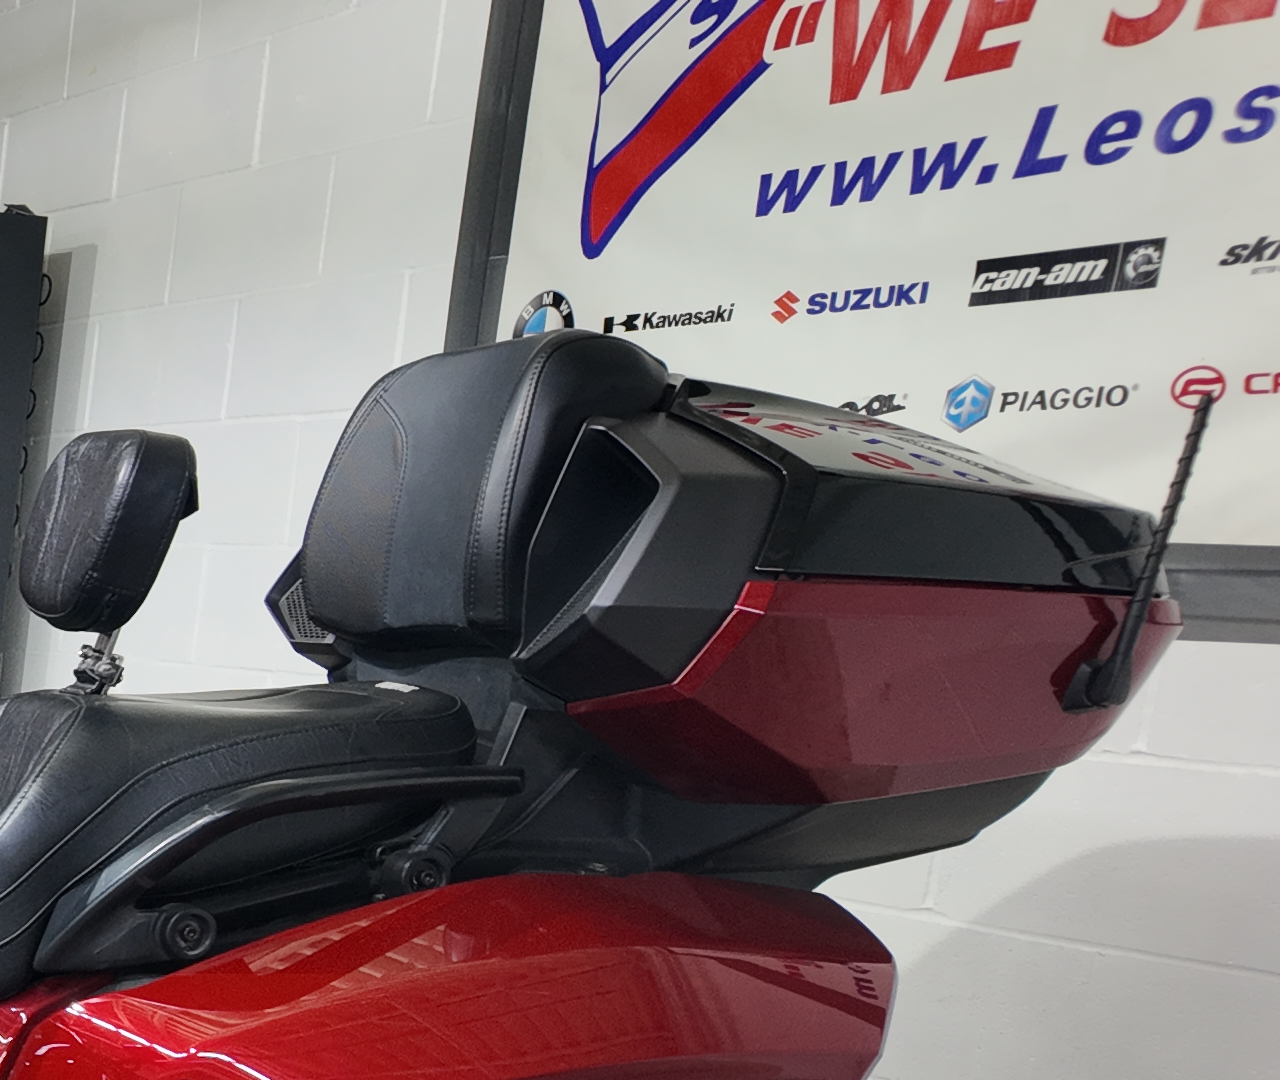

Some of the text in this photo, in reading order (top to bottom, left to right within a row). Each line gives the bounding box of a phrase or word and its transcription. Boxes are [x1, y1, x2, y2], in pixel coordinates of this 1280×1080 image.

[972, 258, 1104, 293] can-am
[521, 291, 572, 319] BMW
[806, 281, 929, 315] SUZUKI
[642, 303, 735, 330] Kawasaki
[999, 384, 1130, 413] PIAGGIO
